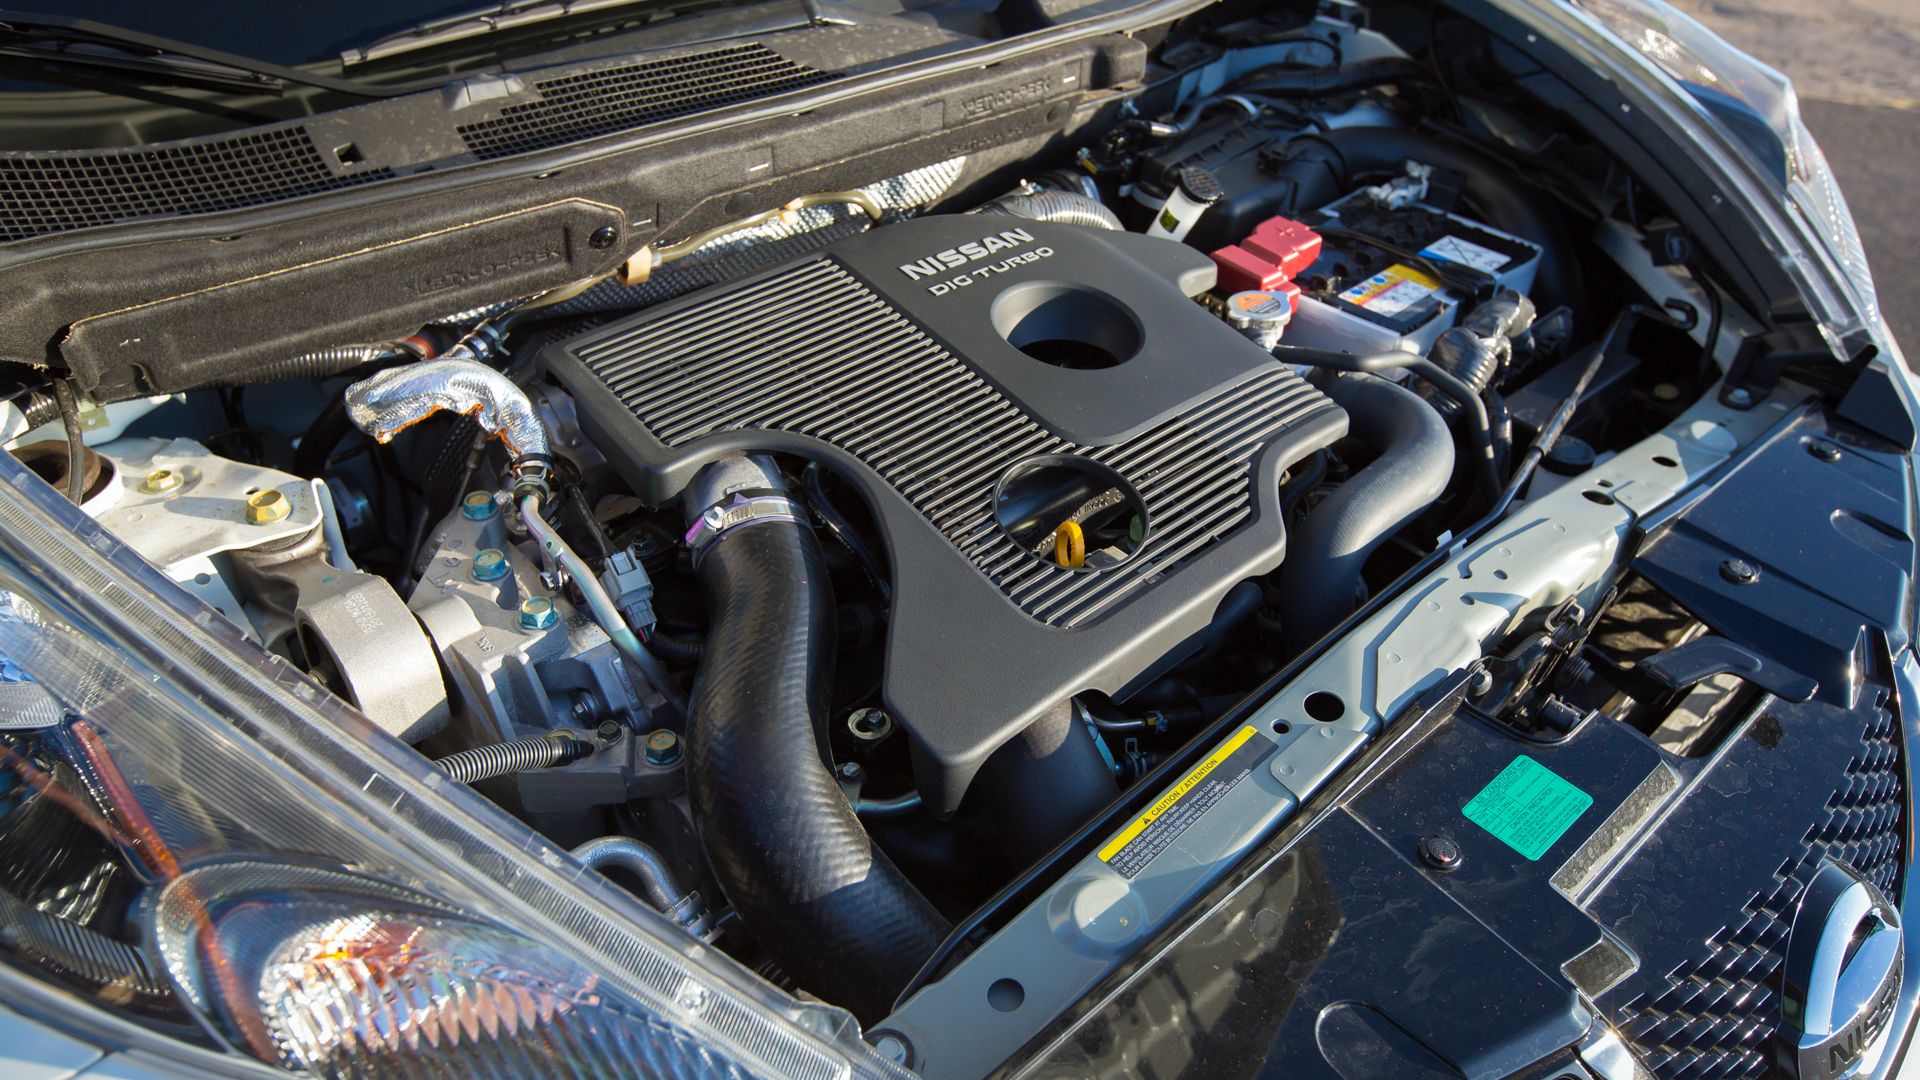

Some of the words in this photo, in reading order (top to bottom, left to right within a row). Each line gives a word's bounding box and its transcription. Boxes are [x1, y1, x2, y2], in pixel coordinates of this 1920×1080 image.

[899, 228, 1035, 281] NISSAN
[928, 274, 973, 296] DIG
[972, 247, 1054, 278] TURBO
[1151, 791, 1180, 816] CAUTION
[1184, 758, 1218, 788] ATTENTION
[1475, 795, 1485, 805] AIR
[1485, 765, 1518, 796] CONDITIONER
[1111, 855, 1121, 864] FAN
[1119, 843, 1134, 857] BLADE
[1133, 835, 1144, 845] CAN
[1142, 824, 1156, 837] START
[1160, 813, 1169, 822] ANY
[1122, 852, 1135, 863] HELP
[1133, 841, 1147, 854] AVOID
[1146, 823, 1168, 843] PERSONAL
[1190, 791, 1205, 804] HANDS
[1127, 864, 1141, 877] POUR
[1193, 810, 1203, 819] PAS
[1128, 844, 1154, 868] VENTILATEUR
[1153, 831, 1169, 846] RISQUE
[1168, 825, 1176, 833] DE
[1199, 796, 1210, 806] TOUT
[1828, 967, 1901, 1074] NISSA
